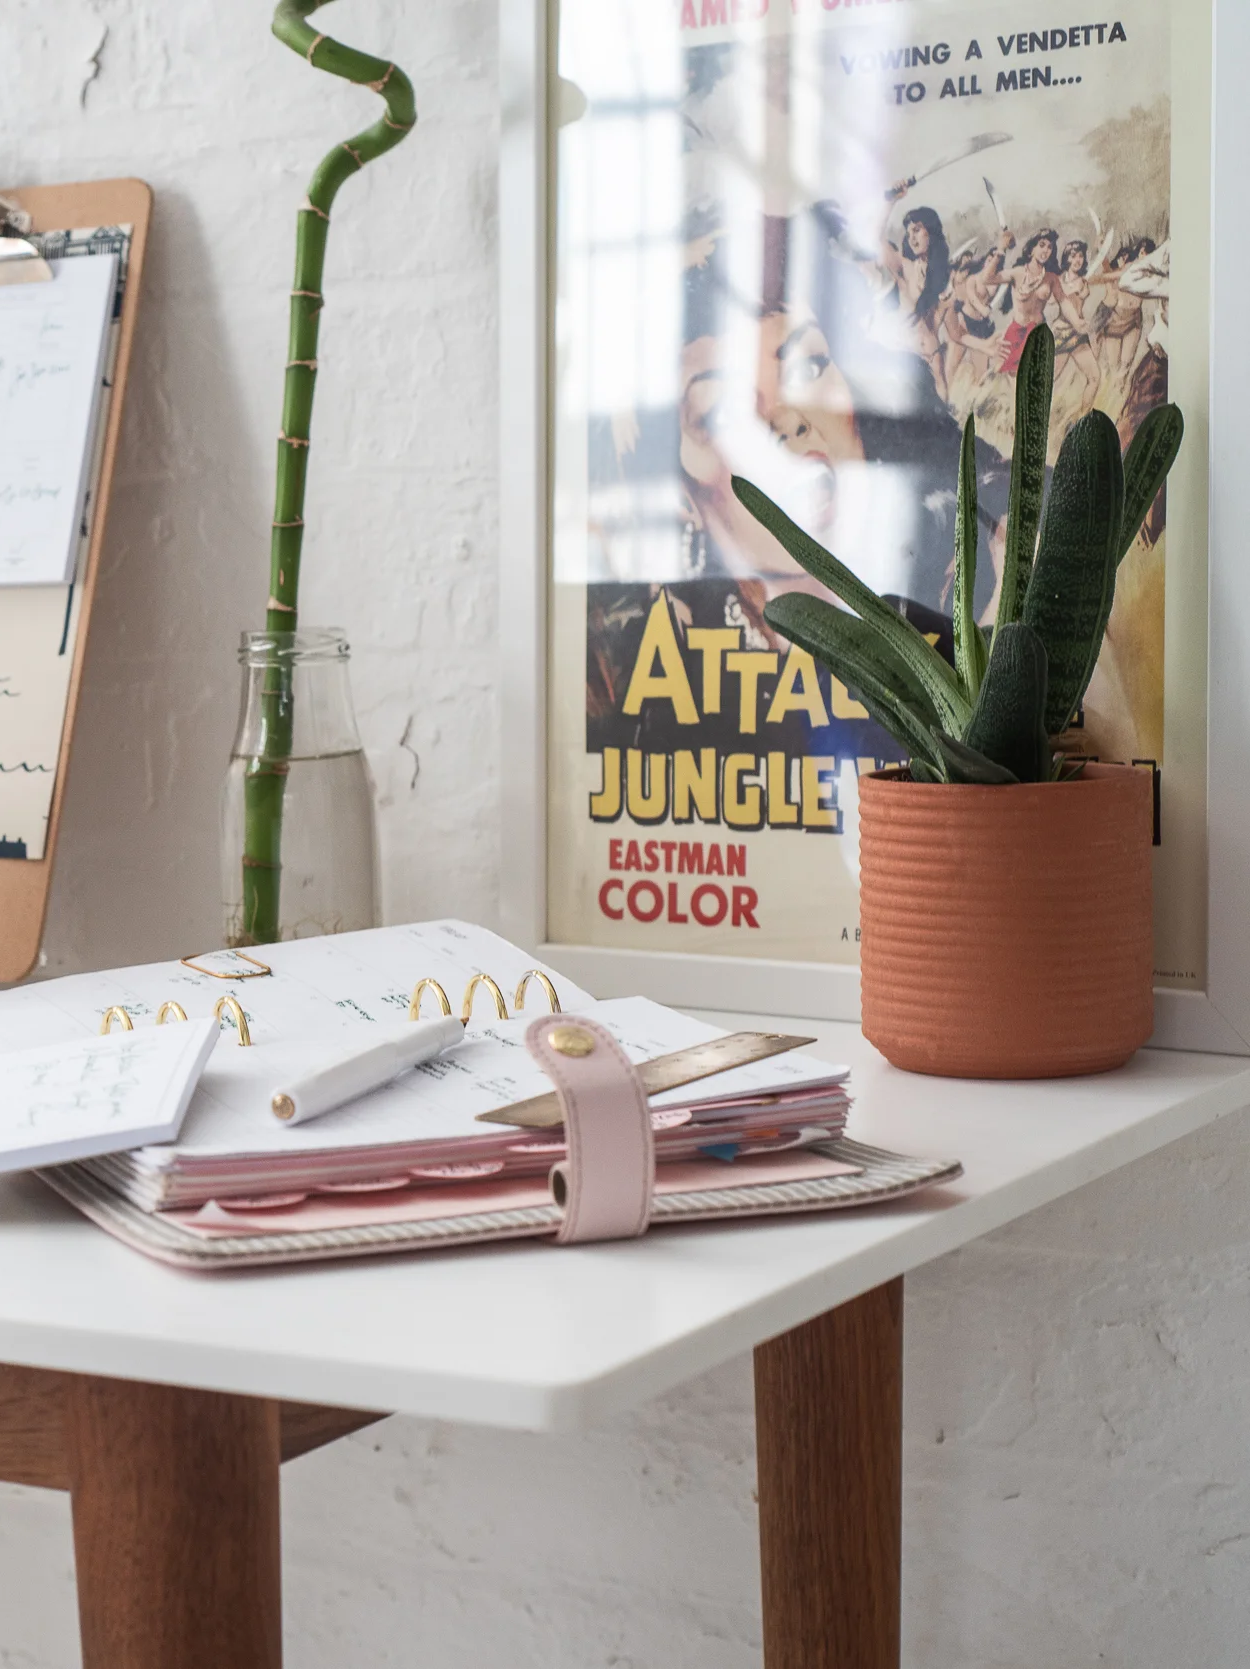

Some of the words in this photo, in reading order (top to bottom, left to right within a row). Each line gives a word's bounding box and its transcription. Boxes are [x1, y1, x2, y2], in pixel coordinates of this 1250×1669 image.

[840, 42, 951, 75] VOWING
[964, 39, 983, 62] A
[996, 21, 1127, 56] VENDETTA
[893, 81, 926, 106] TO
[938, 74, 983, 99] ALL
[995, 66, 1082, 93] MEN....
[589, 745, 844, 835] JUNGLE
[609, 838, 748, 878] EASTMAN
[598, 878, 761, 929] COLOR
